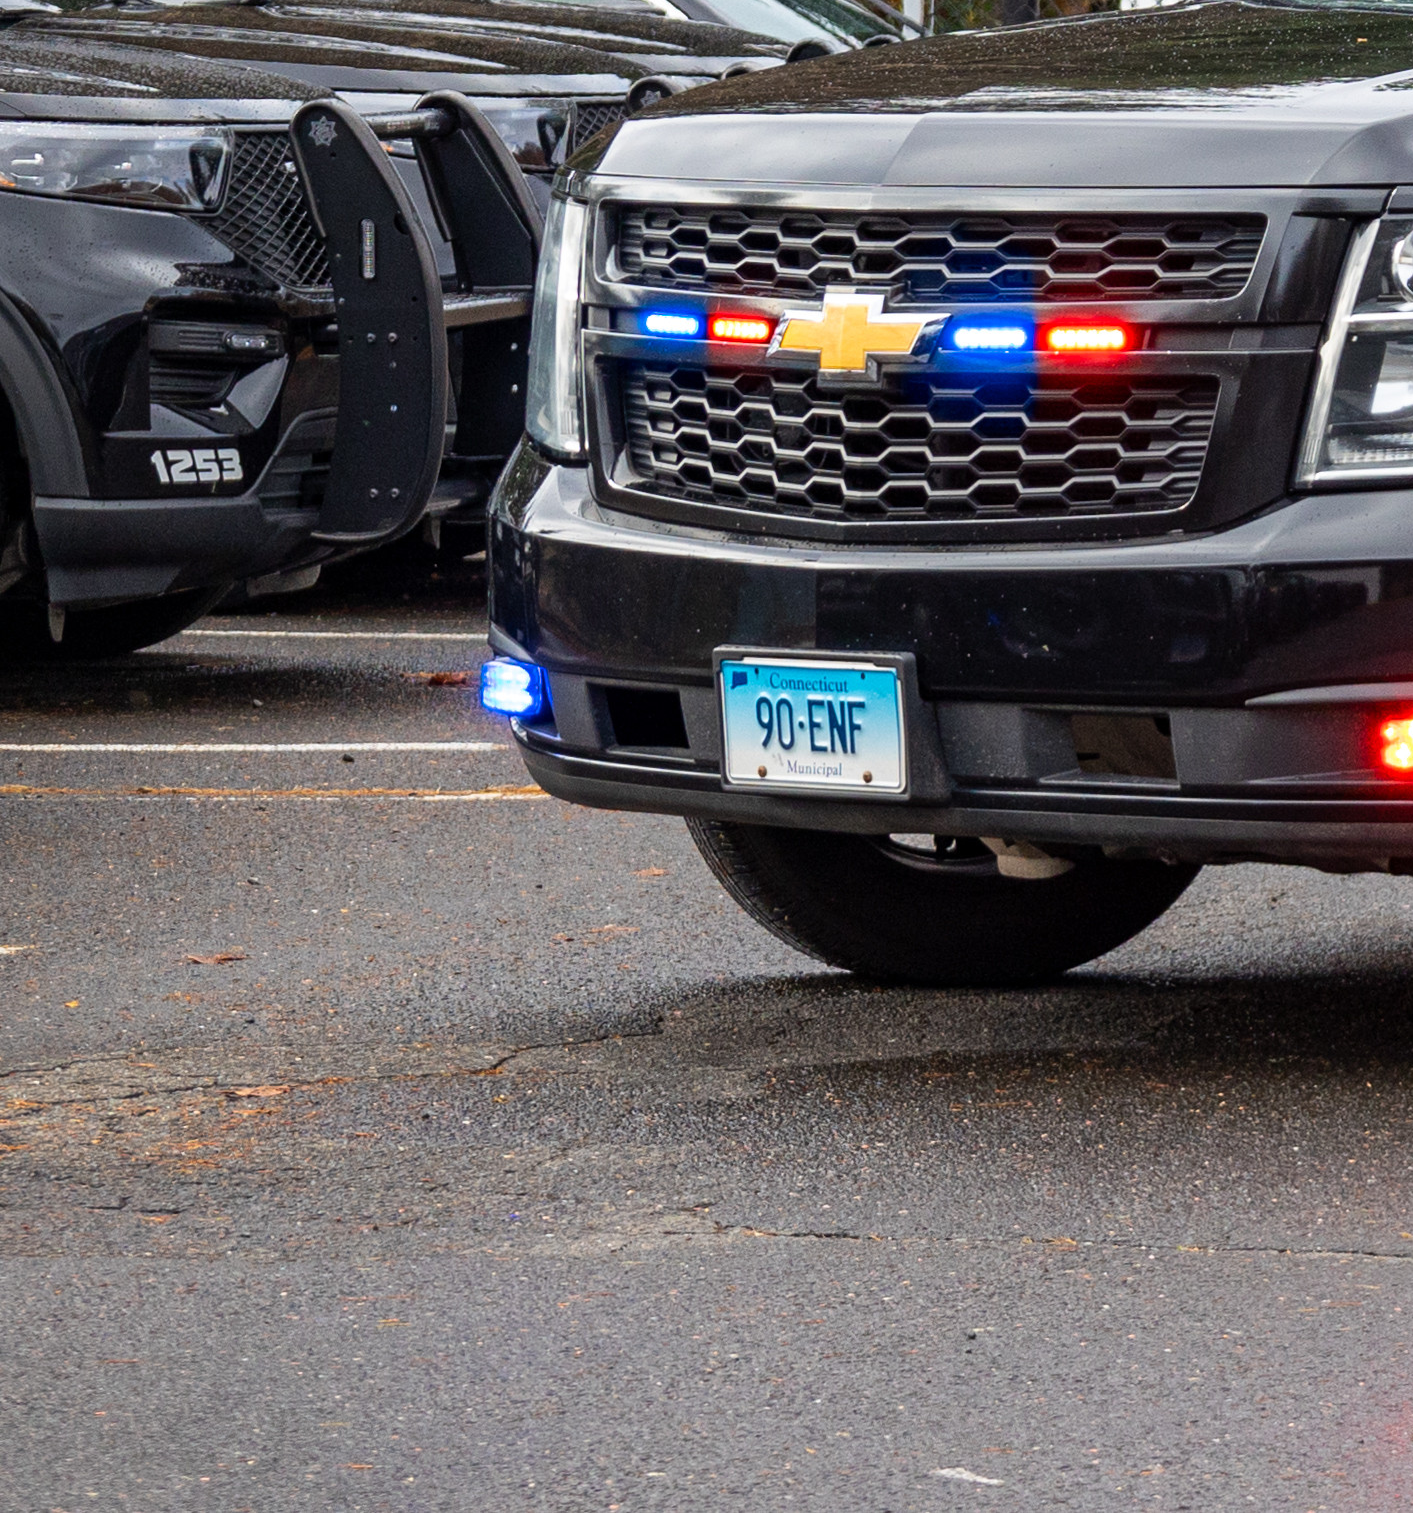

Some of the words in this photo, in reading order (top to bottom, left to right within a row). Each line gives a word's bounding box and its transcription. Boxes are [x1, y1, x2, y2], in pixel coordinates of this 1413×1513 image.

[151, 448, 244, 485] 1253
[769, 673, 849, 693] Connecticut
[786, 759, 843, 778] Municipal
